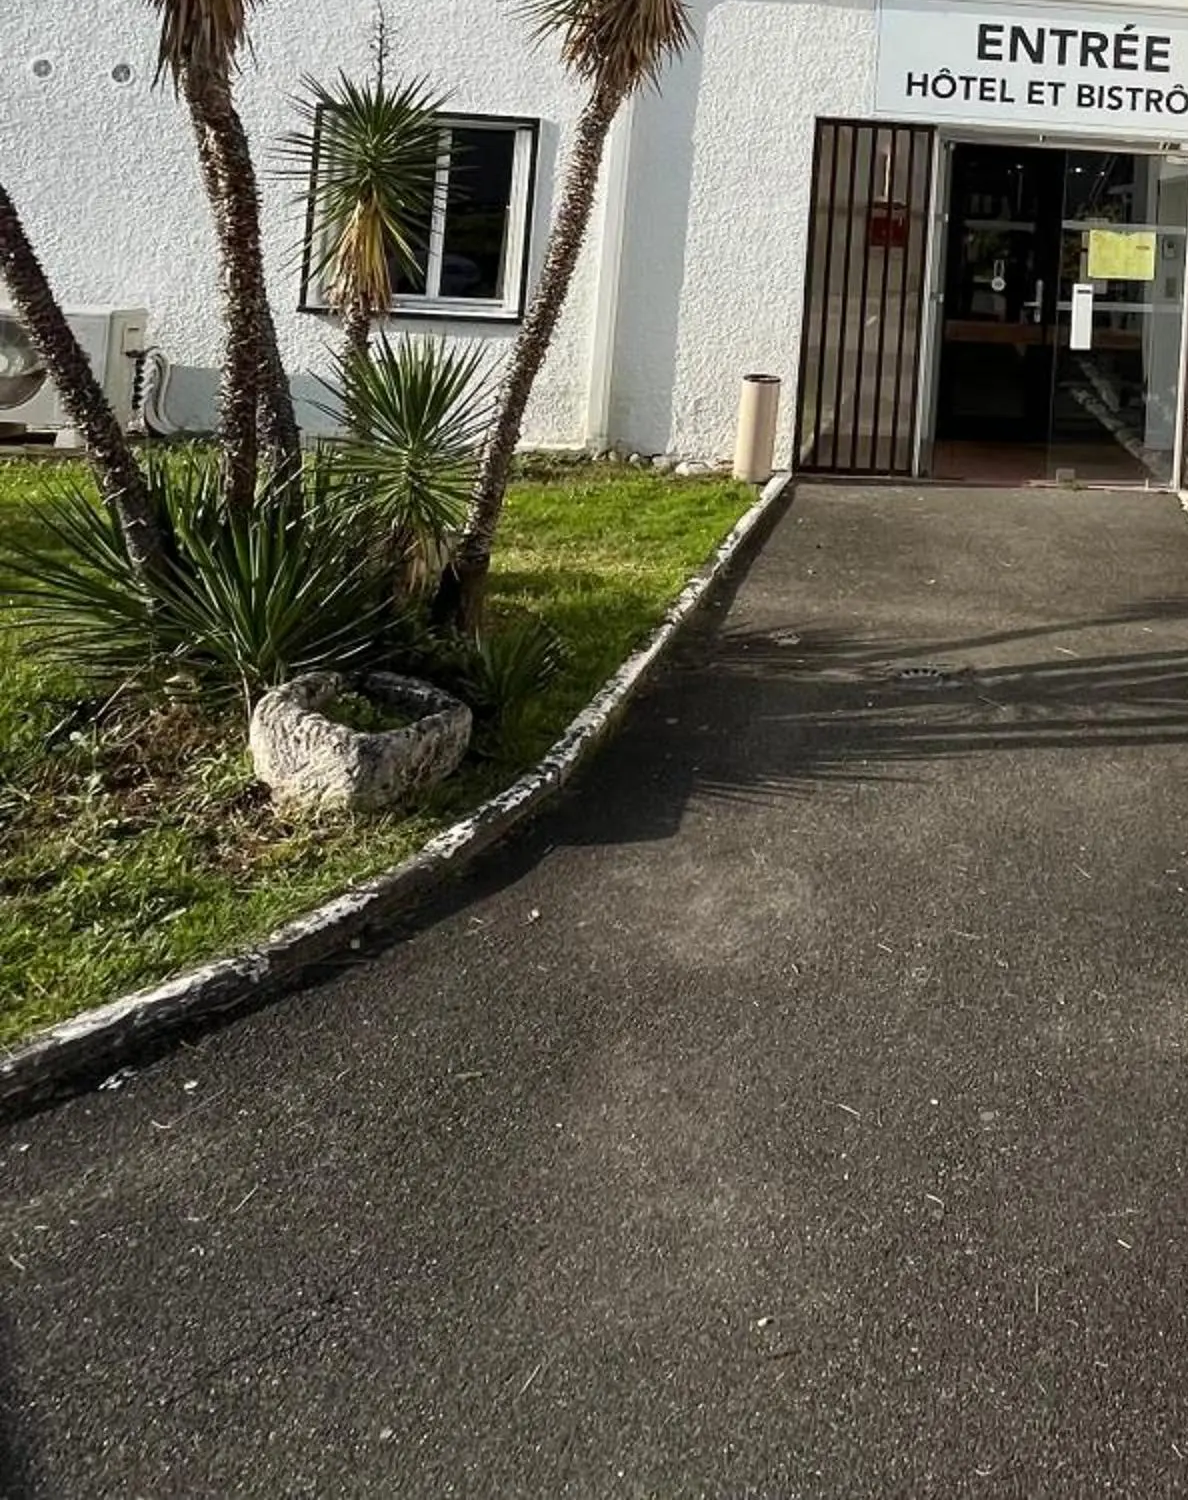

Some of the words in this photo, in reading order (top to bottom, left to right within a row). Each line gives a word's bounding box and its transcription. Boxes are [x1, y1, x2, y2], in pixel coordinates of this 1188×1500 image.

[977, 24, 1171, 73] ENTRÉE
[906, 68, 1015, 104] HÔTEL
[1027, 81, 1066, 106] ET
